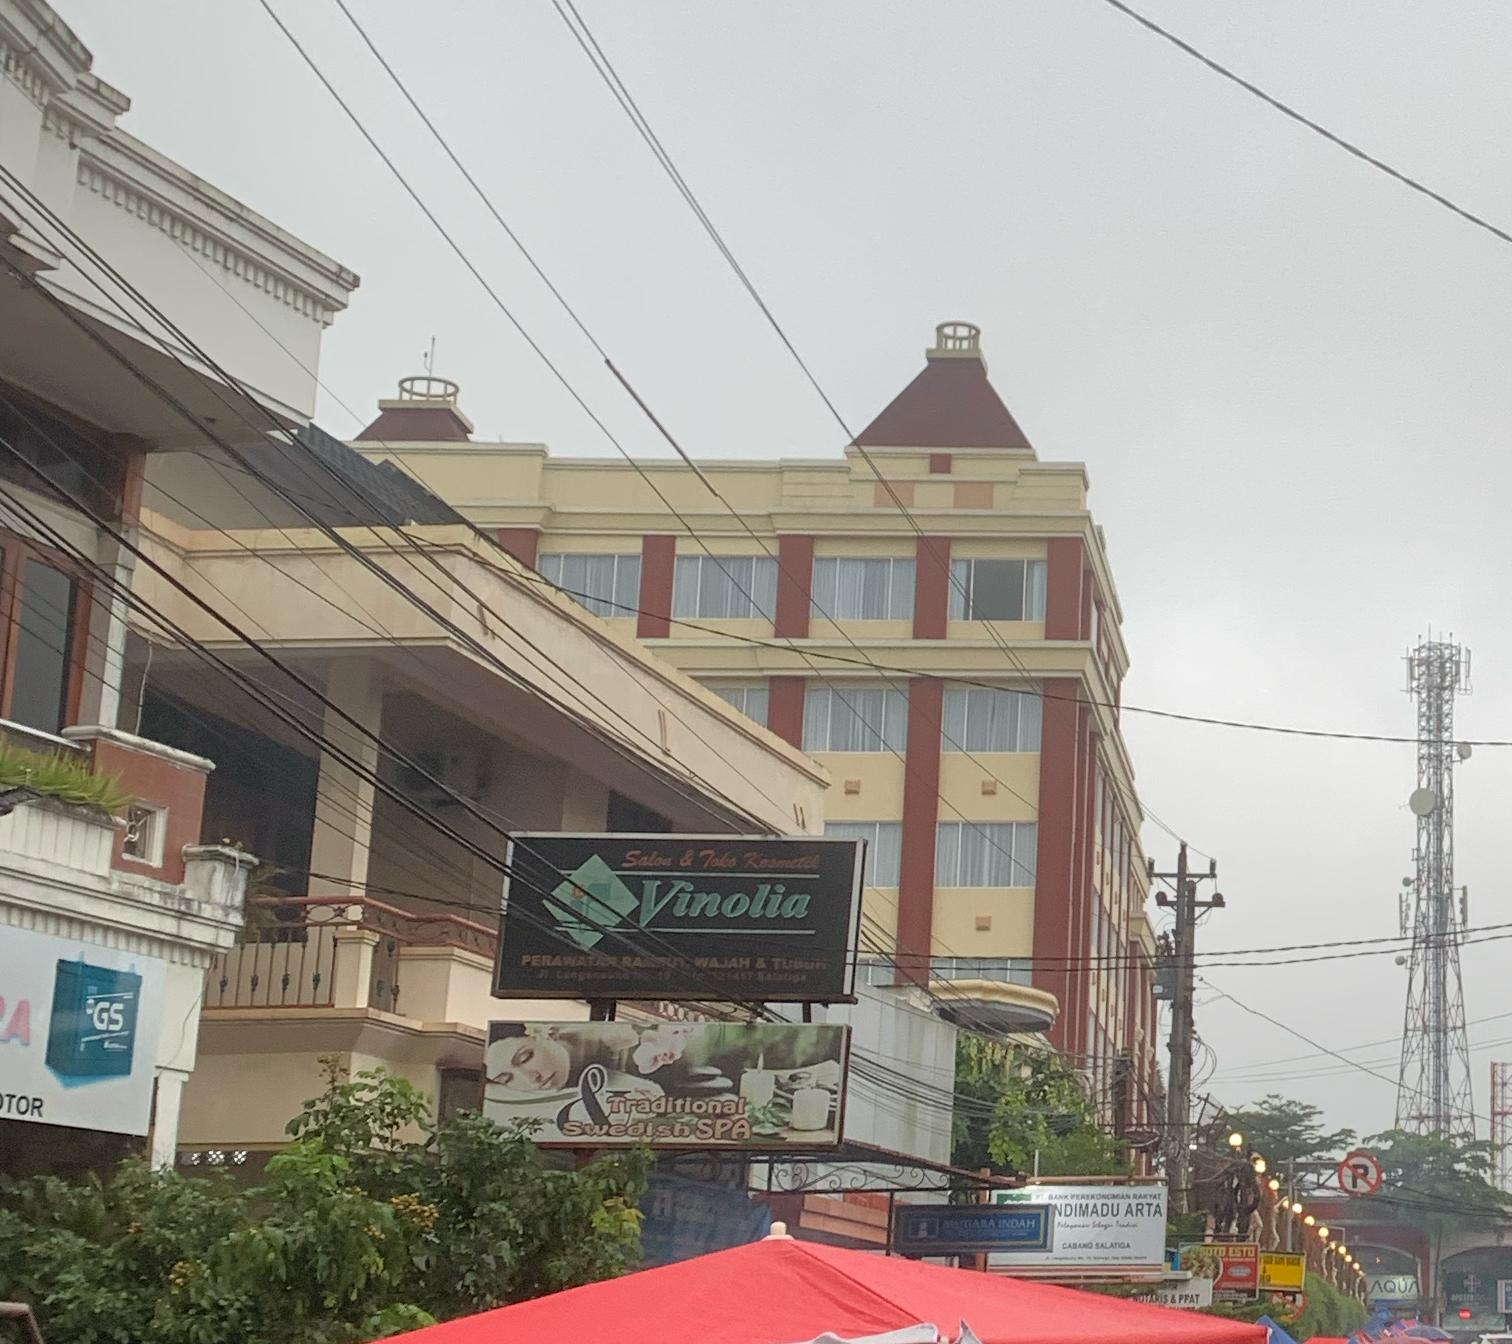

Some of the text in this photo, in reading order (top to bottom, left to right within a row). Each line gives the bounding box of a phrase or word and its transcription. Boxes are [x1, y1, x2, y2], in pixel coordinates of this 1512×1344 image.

[622, 849, 672, 868] Salon
[679, 849, 693, 867] &
[637, 878, 812, 928] Vinolia
[693, 958, 751, 971] WAJAH
[755, 958, 767, 971] &
[0, 995, 30, 1046] A
[93, 1002, 124, 1031] GS
[607, 1095, 746, 1115] Traditional
[562, 1118, 751, 1140] Swedish SPA
[1048, 1193, 1069, 1201] BANK
[1132, 1193, 1162, 1202] RAKYAT
[1054, 1202, 1163, 1218] NDIMADU ARTA
[998, 1218, 1036, 1229] INDAH
[1061, 1242, 1132, 1250] CABANG SALATIGA
[1370, 1279, 1421, 1294] AQUA
[1170, 1294, 1177, 1304] &
[1178, 1294, 1200, 1305] PPAT
